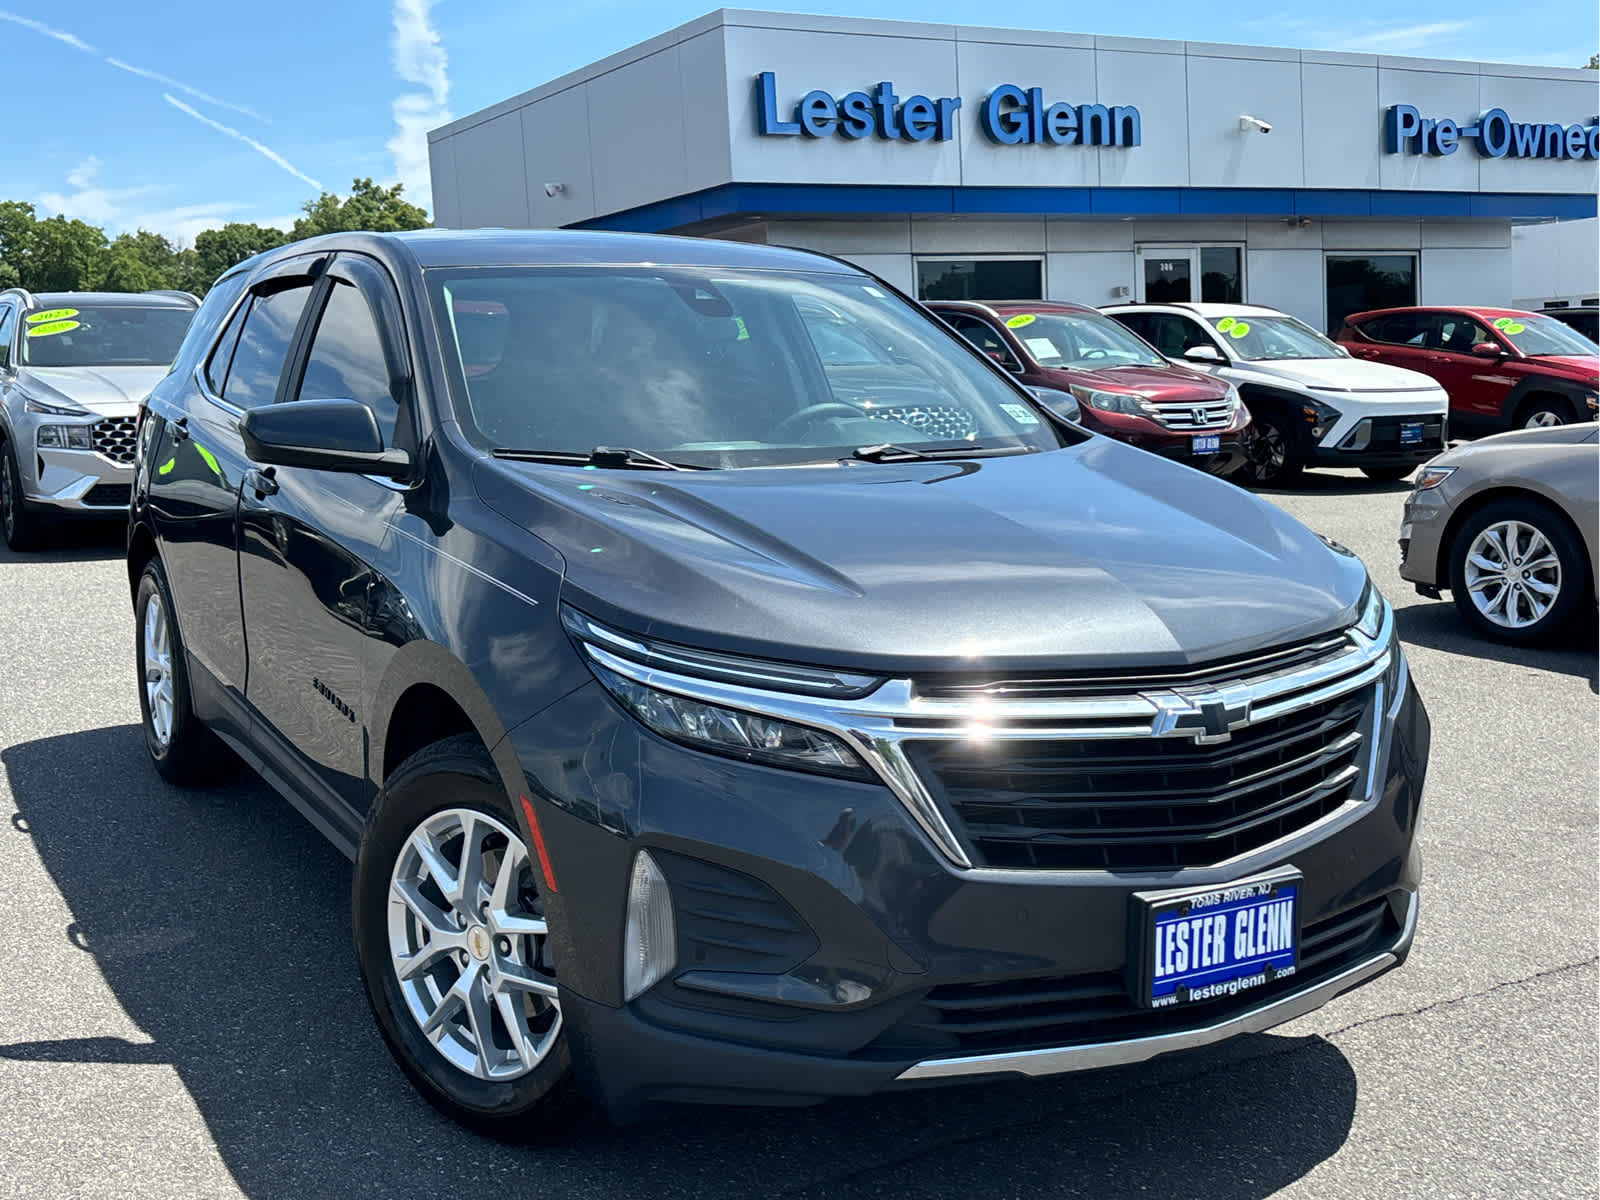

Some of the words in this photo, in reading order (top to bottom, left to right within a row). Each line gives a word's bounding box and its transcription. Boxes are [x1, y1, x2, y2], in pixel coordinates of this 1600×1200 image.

[757, 71, 961, 142] Lester
[982, 83, 1141, 147] Glenn
[1190, 893, 1221, 910] TOMS
[1258, 883, 1272, 896] NJ
[1154, 914, 1227, 977] LESTER
[1233, 900, 1294, 960] GLENN
[1188, 973, 1266, 1001] lesterglenn
